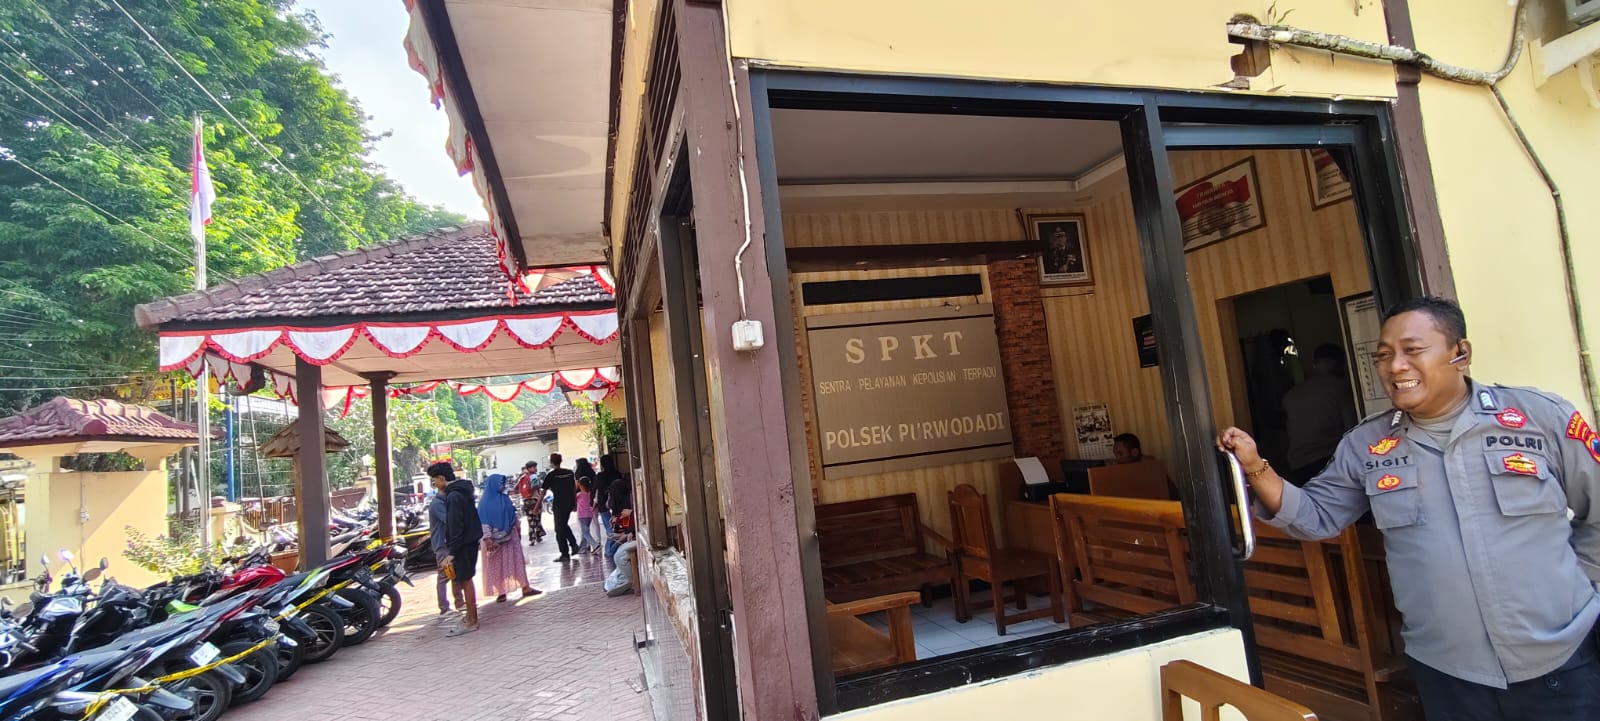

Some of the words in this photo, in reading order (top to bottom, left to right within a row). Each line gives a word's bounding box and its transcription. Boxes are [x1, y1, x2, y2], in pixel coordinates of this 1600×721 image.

[819, 379, 851, 395] SENTRA
[858, 375, 907, 391] PELAYANAN
[912, 369, 957, 385] KEPOLISIAN
[962, 366, 997, 380] TERPADU
[826, 424, 894, 451] POLSEK
[1486, 435, 1543, 451] POLRI
[1365, 455, 1409, 470] SIGIT
